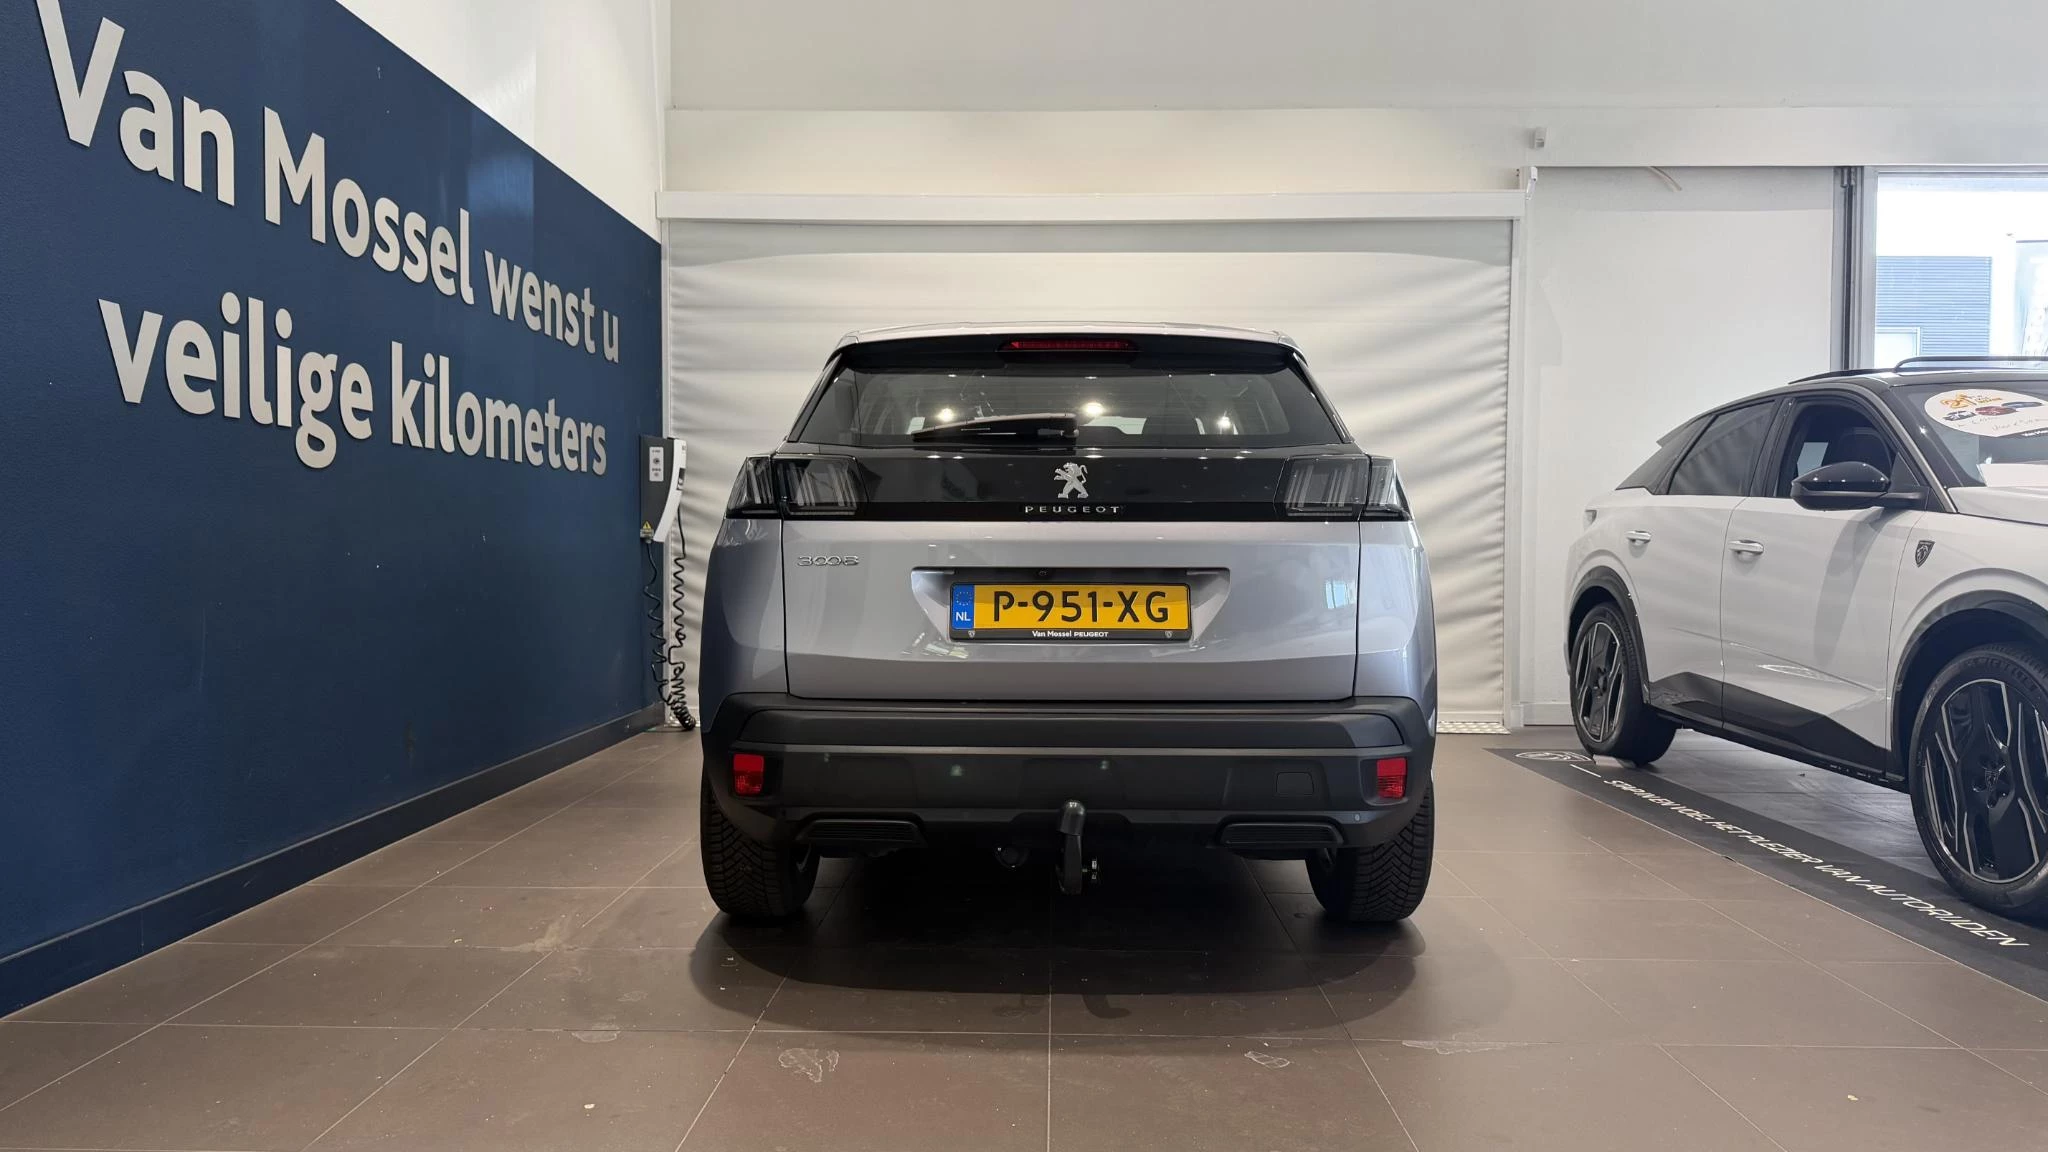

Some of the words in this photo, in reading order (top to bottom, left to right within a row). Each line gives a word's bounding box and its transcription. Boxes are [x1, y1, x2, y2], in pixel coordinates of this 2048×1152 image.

[35, 0, 235, 207] Van
[264, 105, 474, 305] Mossel
[484, 249, 596, 354] wenst
[602, 310, 619, 364] u
[98, 291, 374, 469] veilige
[391, 340, 607, 476] kilometers
[1024, 505, 1120, 514] PEUGEOT
[955, 611, 971, 622] NL
[993, 590, 1169, 623] P-951-XG
[1031, 630, 1046, 638] Van
[1046, 630, 1072, 638] Mossel
[1705, 821, 1753, 836] HET
[1814, 864, 1871, 883] VAN
